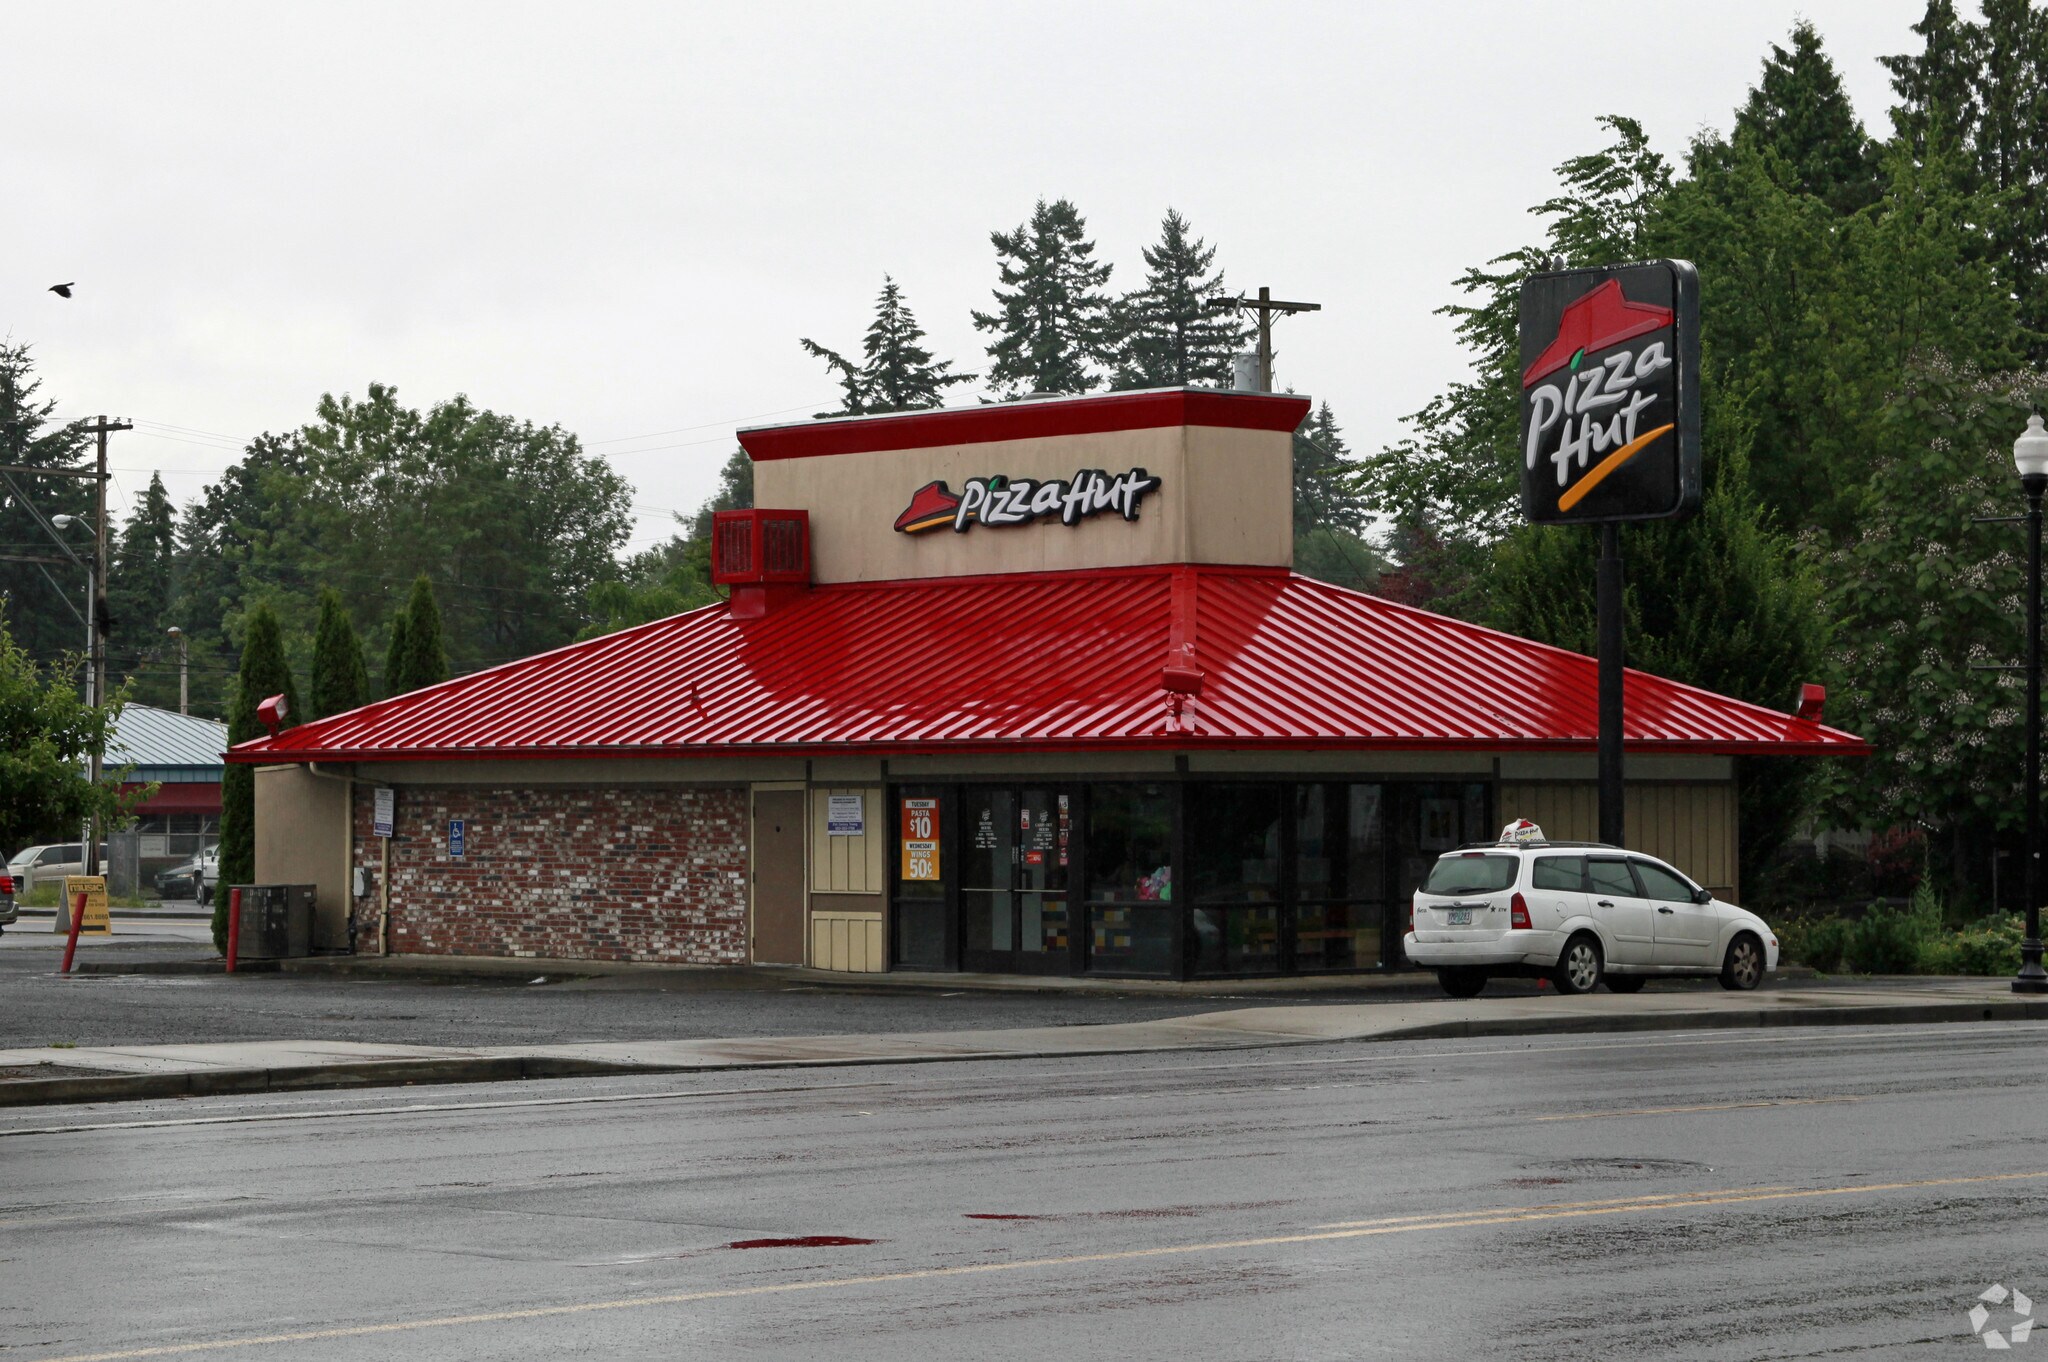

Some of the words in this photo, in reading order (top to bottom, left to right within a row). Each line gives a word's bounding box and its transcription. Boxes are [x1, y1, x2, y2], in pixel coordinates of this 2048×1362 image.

[1526, 341, 1672, 471] Pizza
[1550, 390, 1658, 487] Hut
[954, 477, 1063, 530] Pizza
[1061, 471, 1152, 523] Hut
[909, 816, 932, 839] $10
[909, 858, 933, 878] 50¢
